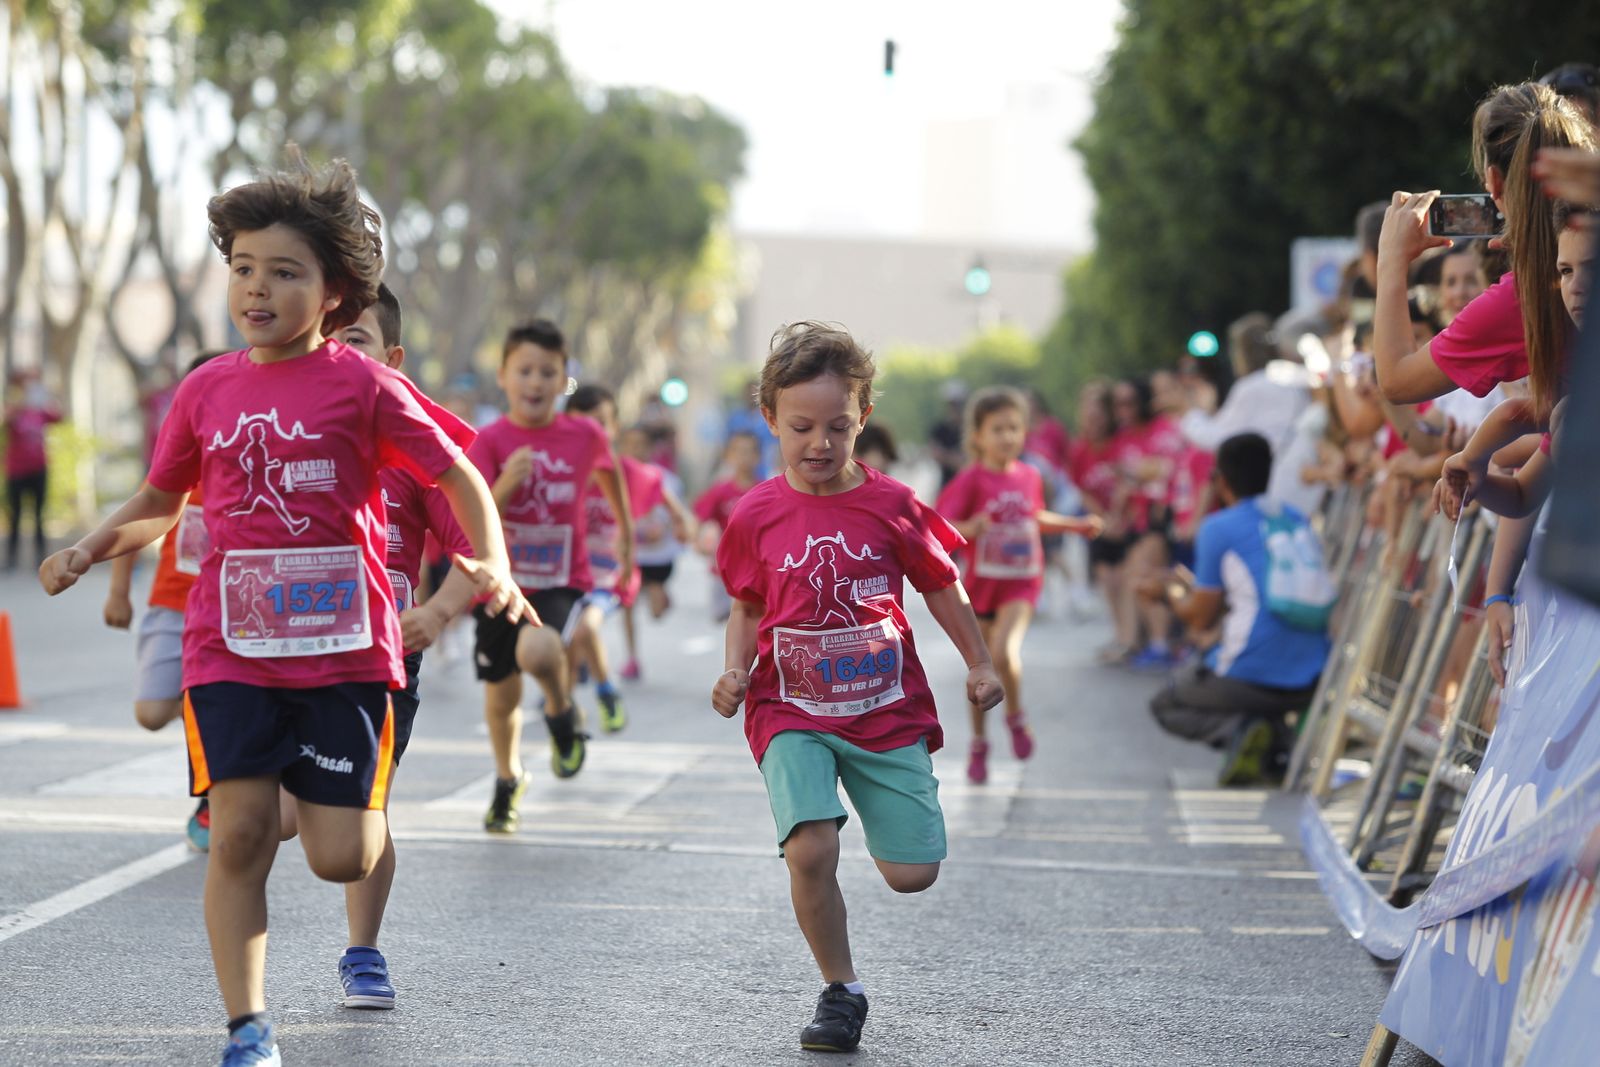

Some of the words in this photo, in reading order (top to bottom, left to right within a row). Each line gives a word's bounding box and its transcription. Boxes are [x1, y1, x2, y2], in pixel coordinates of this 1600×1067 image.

[279, 462, 294, 493] 4
[290, 459, 336, 472] CARRERA
[291, 470, 337, 482] SOLIDARIA
[280, 555, 318, 566] CARRERA
[859, 575, 888, 588] CARRERA
[859, 584, 889, 597] SOLIDARIA
[265, 580, 358, 615] 1527
[288, 614, 337, 627] CAYETANO
[825, 633, 860, 644] CARRERA
[815, 649, 896, 683] 1649
[831, 684, 849, 694] EDU
[851, 681, 867, 692] VER
